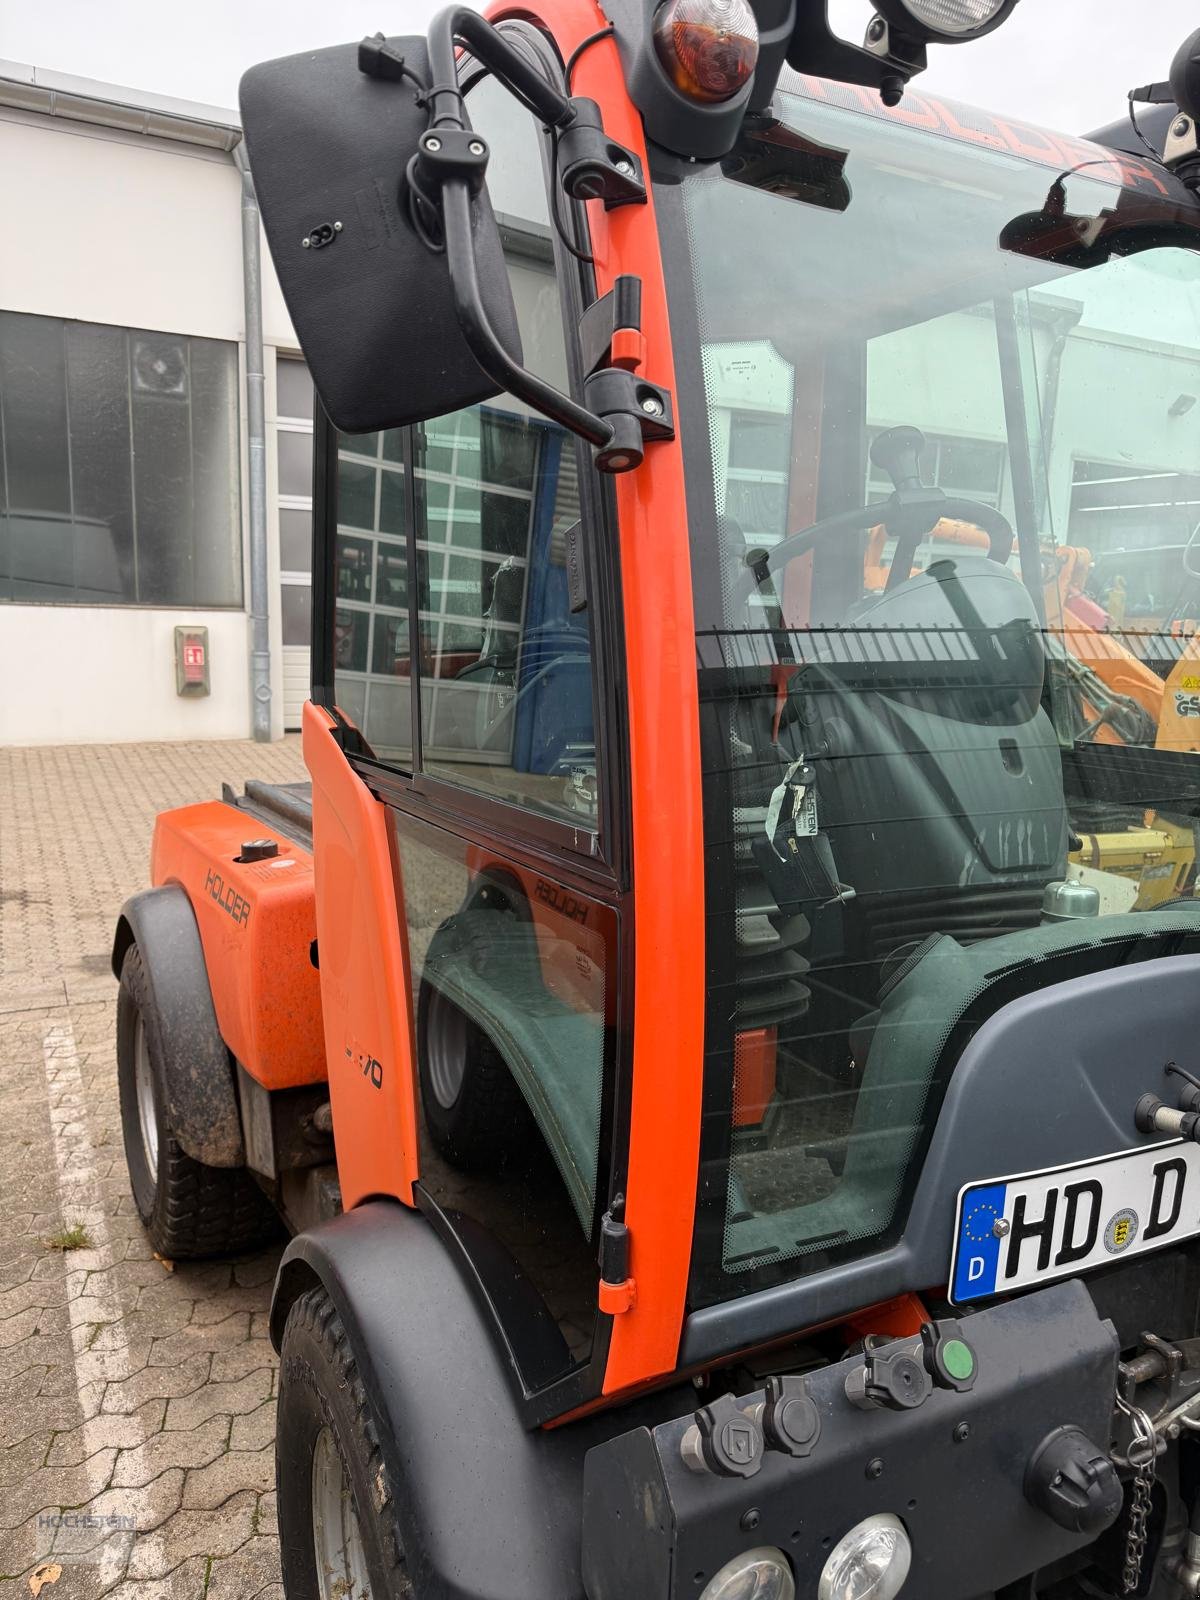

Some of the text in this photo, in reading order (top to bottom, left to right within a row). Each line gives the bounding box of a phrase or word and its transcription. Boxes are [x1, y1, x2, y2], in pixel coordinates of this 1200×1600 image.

[807, 789, 817, 834] CHSTEIN
[204, 867, 251, 929] HOLDER
[1004, 1178, 1103, 1279] HD
[1142, 1157, 1187, 1241] D
[967, 1256, 985, 1282] D
